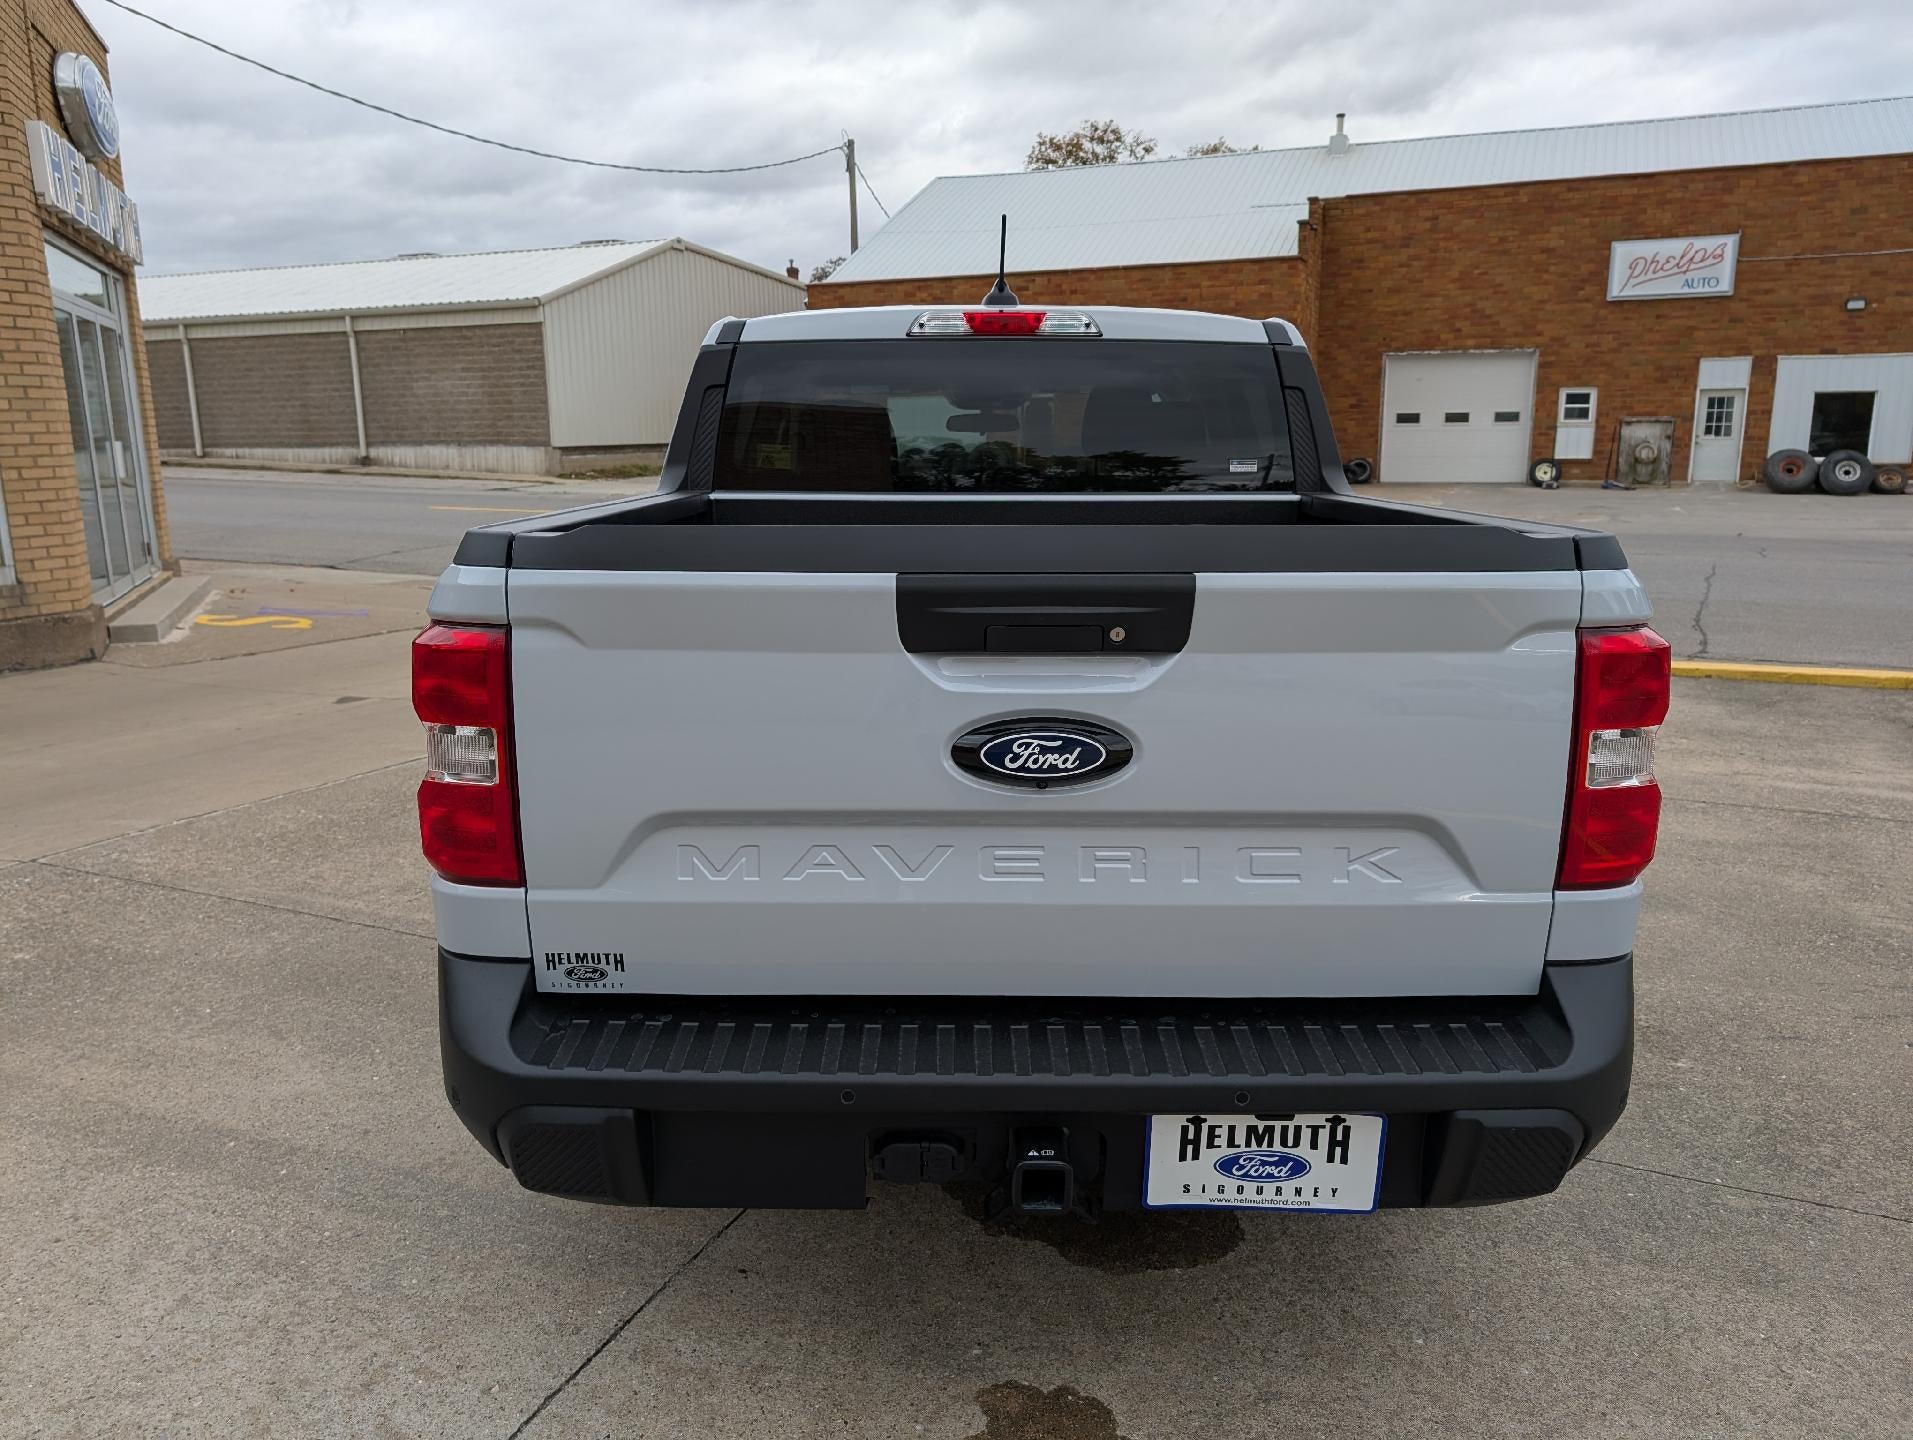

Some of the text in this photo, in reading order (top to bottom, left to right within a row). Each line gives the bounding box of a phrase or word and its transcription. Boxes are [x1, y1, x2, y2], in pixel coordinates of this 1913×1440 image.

[1618, 241, 1728, 294] Phelps
[1681, 276, 1720, 290] AUTO
[1005, 738, 1083, 769] Ford
[676, 844, 1404, 884] MAVERICK
[545, 952, 625, 972] HELMUTH
[571, 967, 601, 979] Ford
[1178, 1124, 1352, 1165] HELMUTH
[1231, 1154, 1295, 1178] Ford
[1182, 1183, 1340, 1198] SIGOURNEY
[1208, 1196, 1312, 1207] www.helmuthford.com
